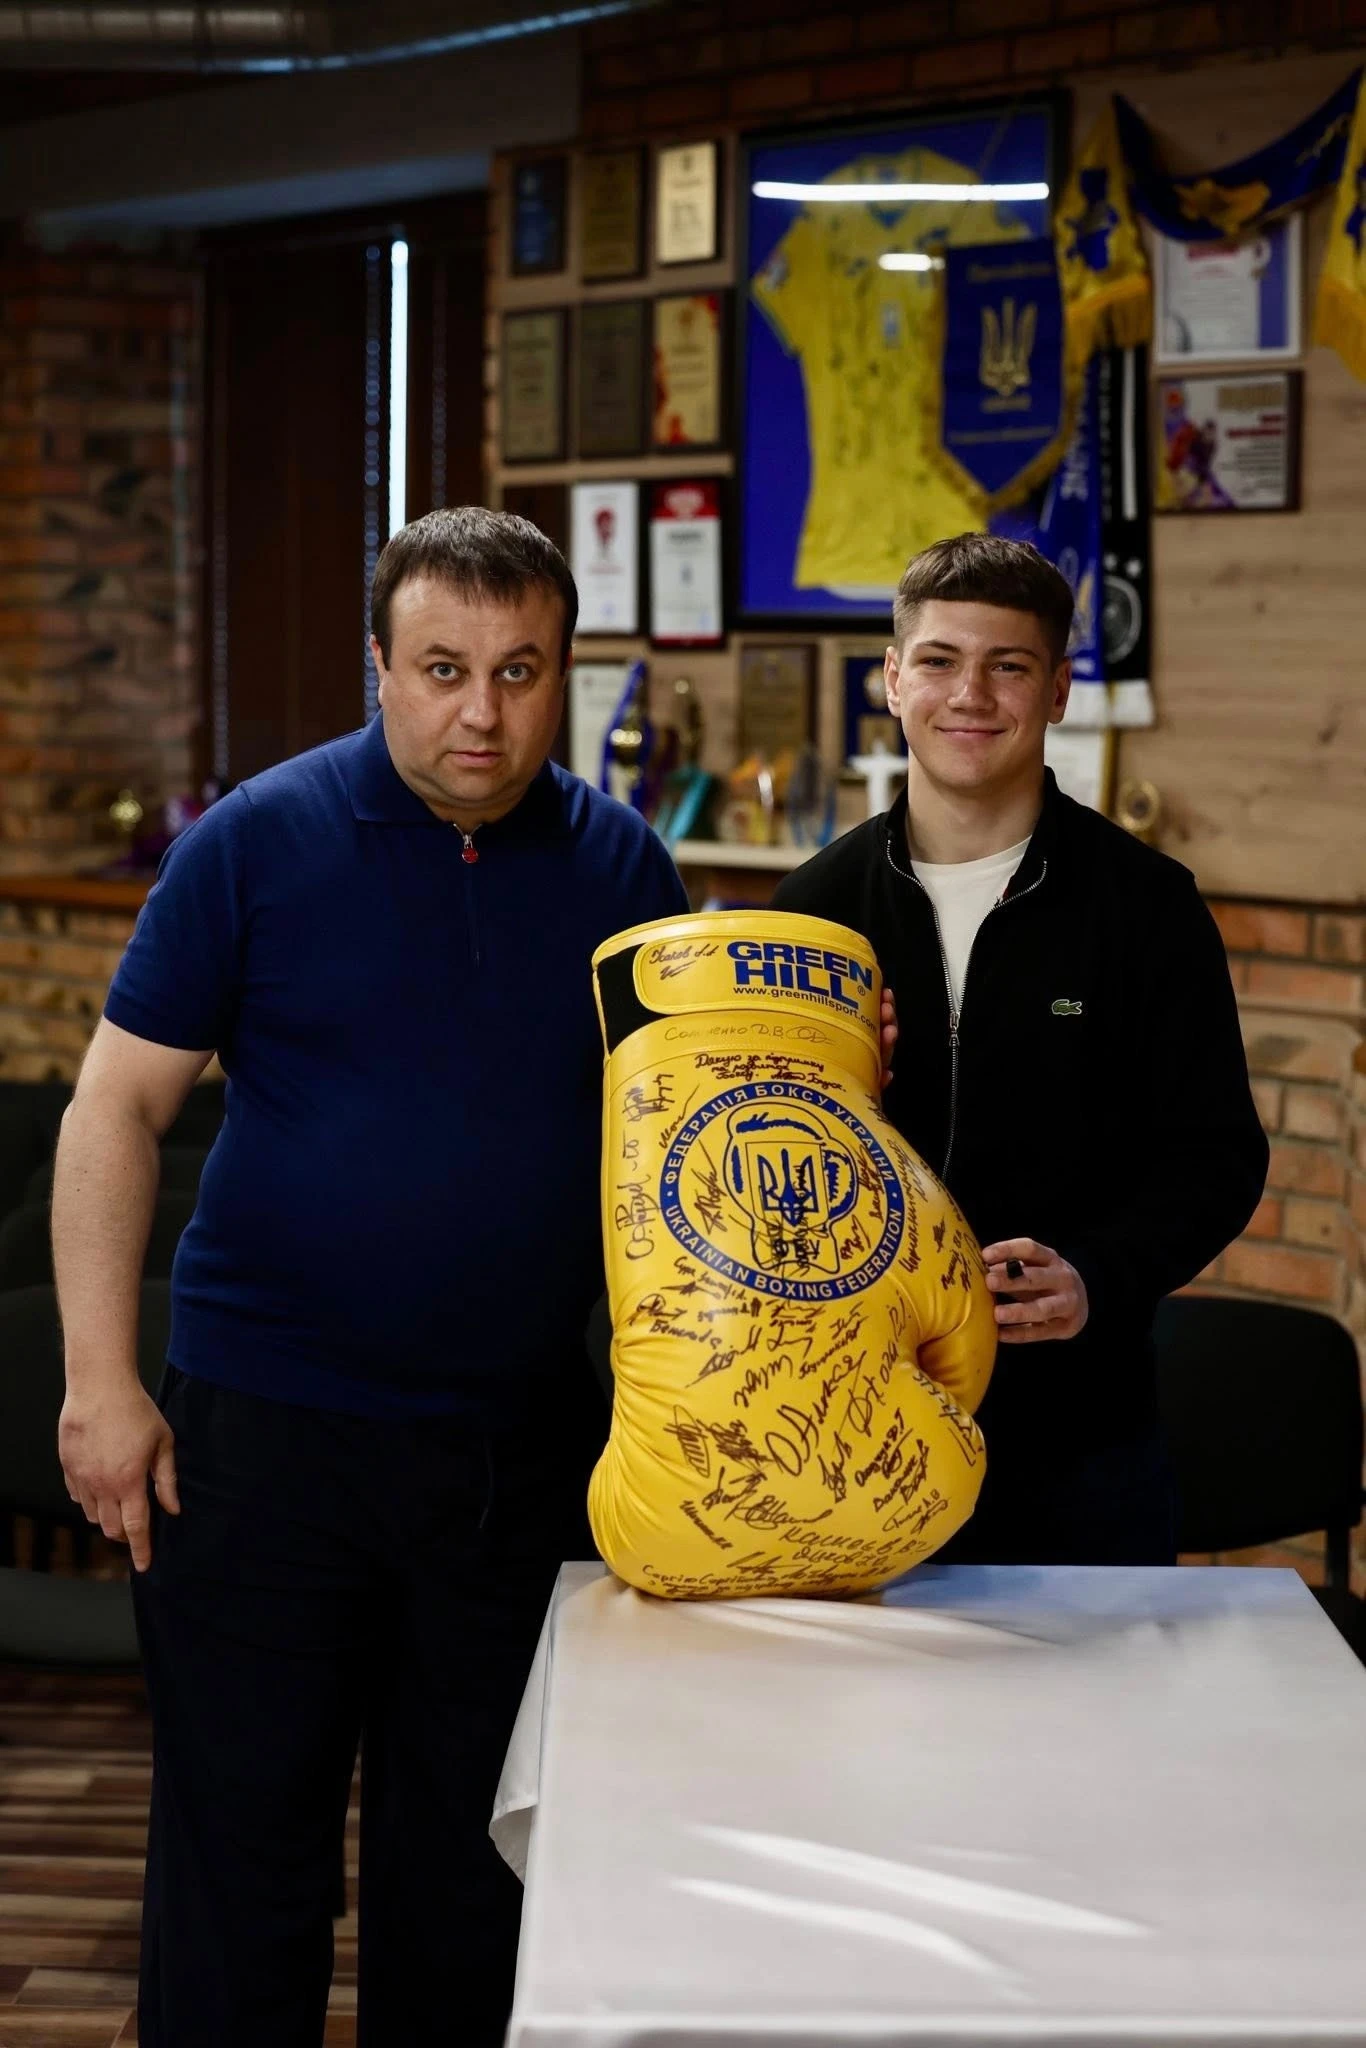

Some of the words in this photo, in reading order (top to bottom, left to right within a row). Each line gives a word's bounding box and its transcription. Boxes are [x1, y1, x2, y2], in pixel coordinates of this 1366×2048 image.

[727, 941, 873, 991] GREEN
[734, 961, 859, 1010] HILL
[665, 1090, 748, 1184] ФЕДЕРАЦІЯ
[754, 1084, 828, 1105] БОКСУ
[665, 1205, 750, 1281] UKRAINIAN
[754, 1274, 832, 1299] BOXING
[836, 1209, 903, 1295] FEDERATION
